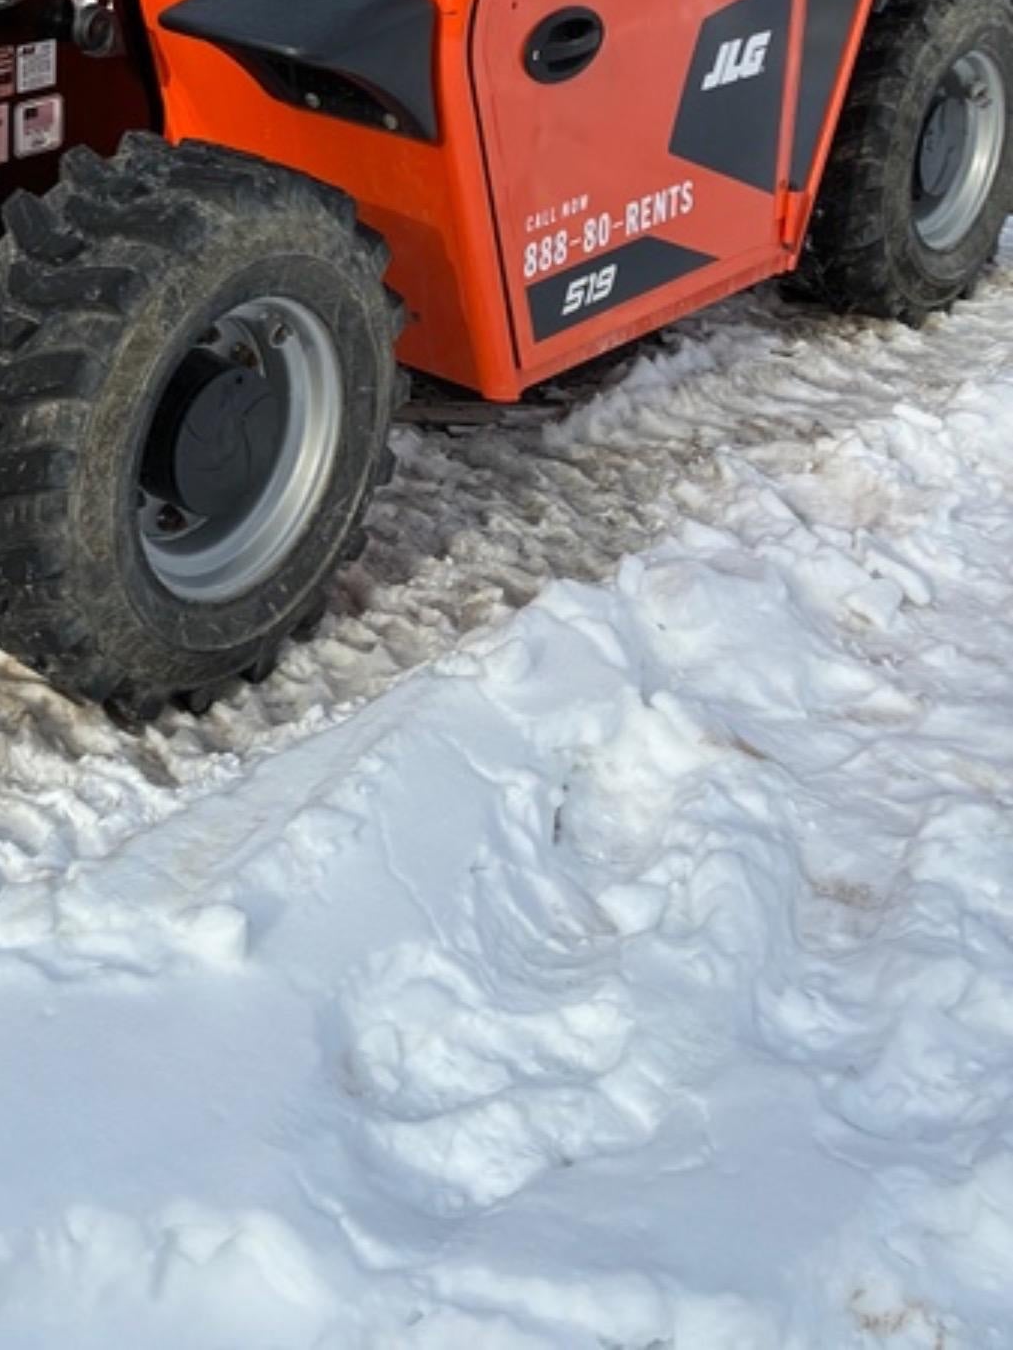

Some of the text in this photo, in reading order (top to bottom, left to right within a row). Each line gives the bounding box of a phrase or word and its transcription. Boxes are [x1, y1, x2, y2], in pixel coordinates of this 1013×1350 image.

[701, 29, 772, 91] JLG
[524, 180, 694, 278] 888-80-RENTS
[526, 194, 589, 232] CALL NOW
[562, 263, 618, 316] 519
